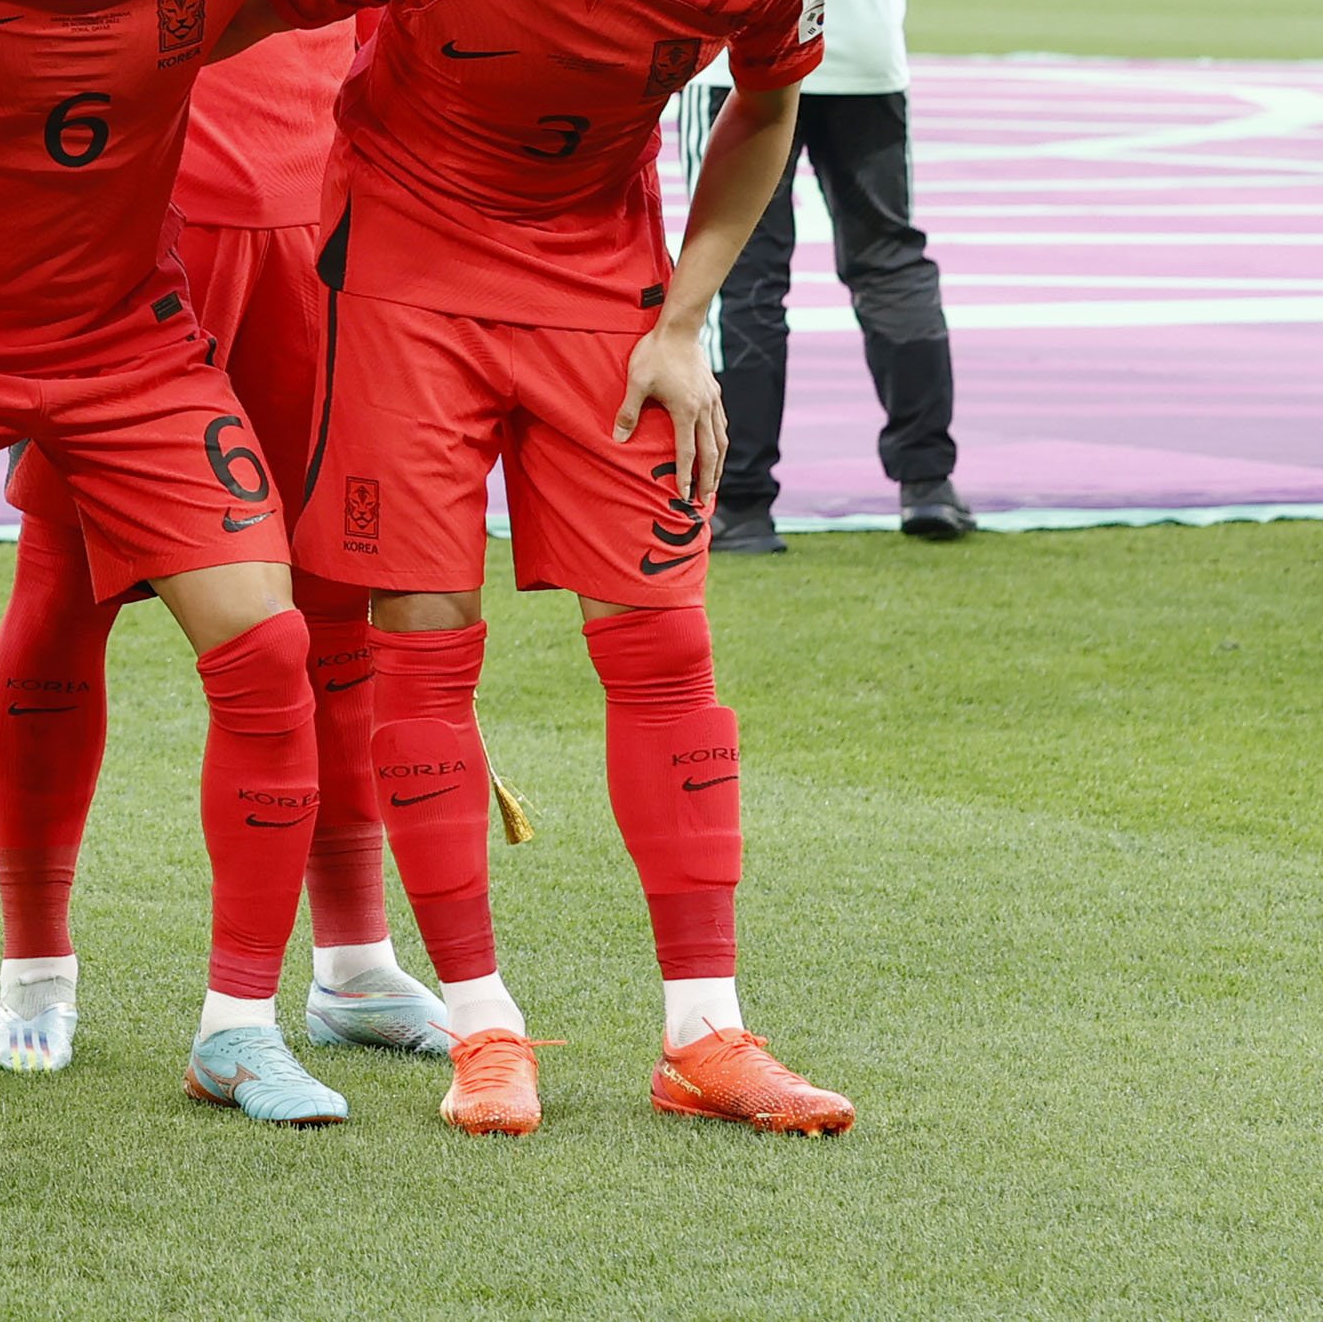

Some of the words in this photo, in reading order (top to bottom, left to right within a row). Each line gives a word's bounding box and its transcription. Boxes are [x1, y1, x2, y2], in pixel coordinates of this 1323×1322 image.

[156, 47, 202, 70] KOREA
[44, 92, 111, 168] 6
[522, 115, 591, 159] 3
[204, 415, 269, 502] 6
[343, 540, 379, 556] KOREA
[317, 647, 370, 668] KOR
[6, 676, 91, 694] KOREA
[671, 747, 740, 768] KORE
[378, 760, 467, 780] KOREA
[662, 1062, 703, 1097] ULTRA
